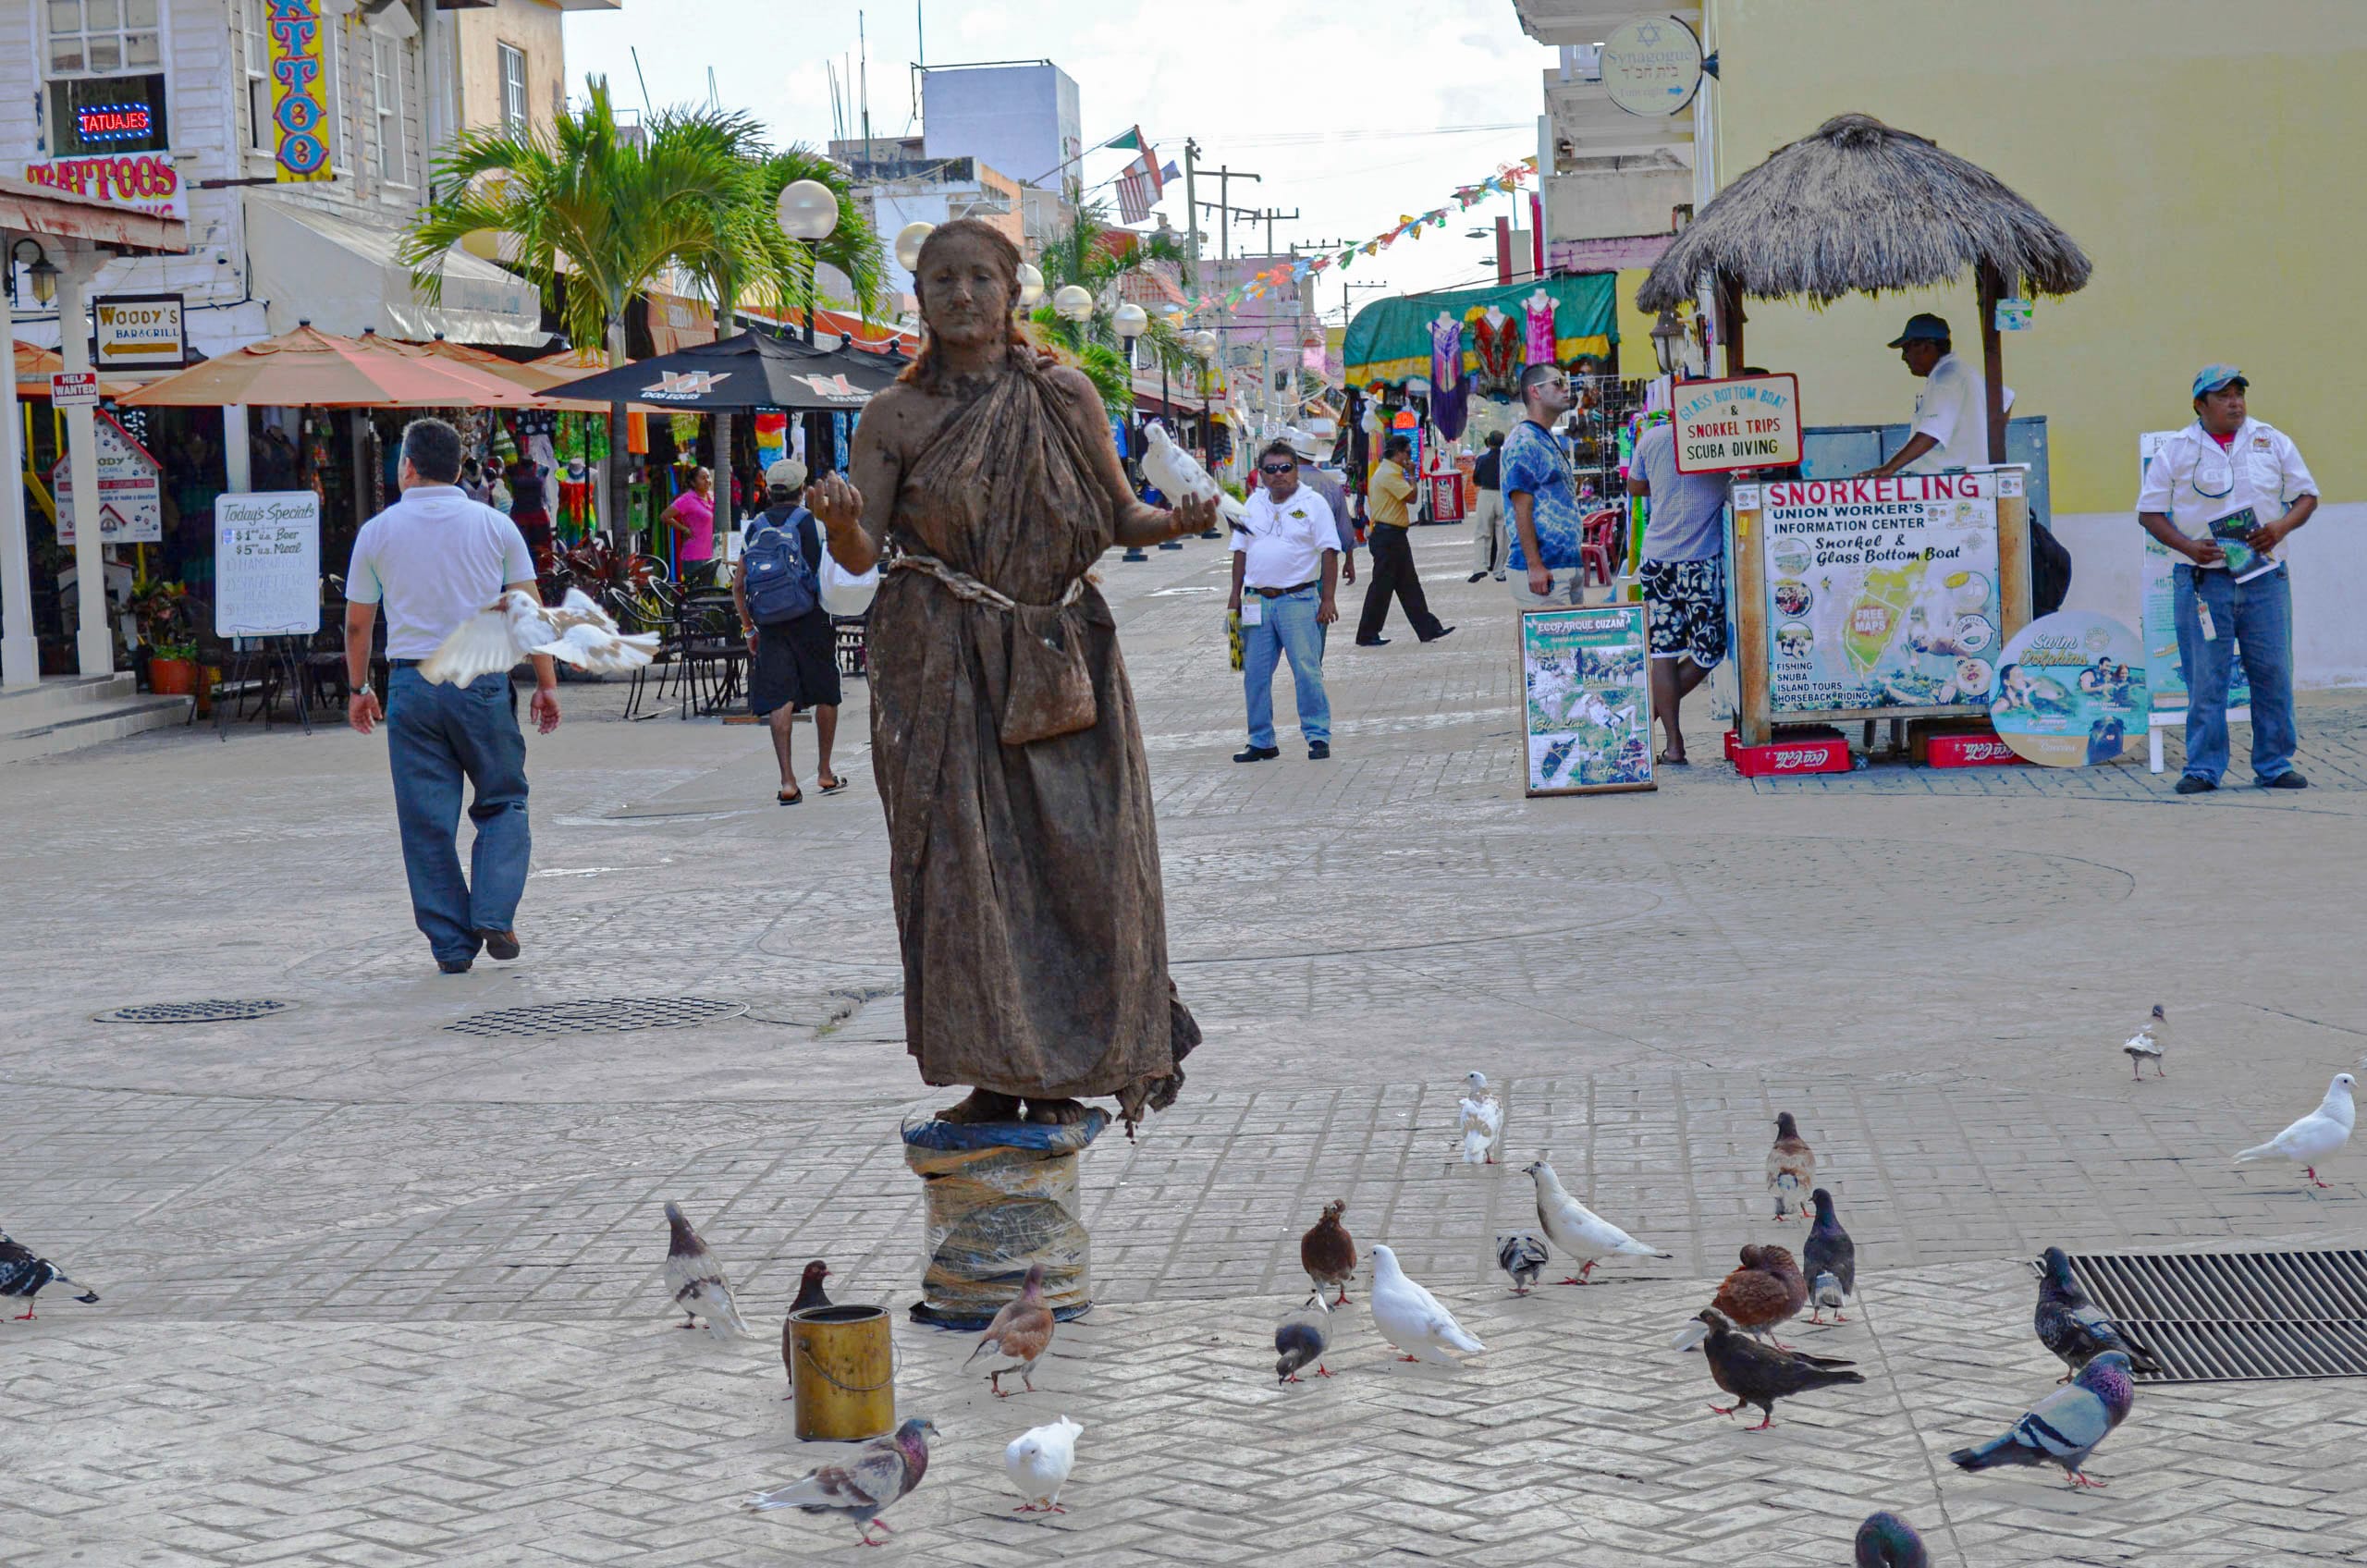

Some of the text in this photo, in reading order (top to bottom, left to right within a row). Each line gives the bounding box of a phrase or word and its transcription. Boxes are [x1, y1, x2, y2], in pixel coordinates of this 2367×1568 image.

[1607, 50, 1694, 67] Synagogue
[80, 112, 148, 131] TATUAJES
[26, 155, 178, 201] TATTOOS
[98, 305, 178, 326] WOODY'S
[61, 374, 87, 385] HELP
[55, 384, 95, 397] WANTED
[640, 390, 701, 400] DOS EQUIS
[1679, 386, 1788, 422] GLASS BOTTOM BOAT
[1731, 405, 1739, 416] &
[1687, 418, 1781, 439] SNORKEL TRIPS
[1687, 439, 1778, 460] SCUBA DIVING
[1769, 473, 1980, 507] SNORKELING
[1439, 487, 1449, 518] TECATE
[223, 502, 314, 526] Today's Specials
[1773, 503, 1924, 520] UNION WORKER'S
[275, 527, 300, 541] Beer
[1773, 517, 1925, 534] INFORMATION CENTER
[274, 542, 302, 555] Meal
[1815, 533, 1907, 550] Snorkel &
[1816, 545, 1960, 568] Glass Bottom Boat
[1856, 608, 1884, 619] FREE
[1538, 619, 1625, 633] ECOPARQUE CUZAM
[1855, 620, 1886, 631] MAPS
[2030, 631, 2079, 650] Swim
[1776, 661, 1813, 671] FISHING
[2018, 648, 2090, 672] Dolphins
[1777, 672, 1808, 682] SNUBA
[1777, 681, 1843, 692] ISLAND TOURS
[1777, 692, 1869, 704] HORSEBACK RIDING
[1559, 718, 1586, 729] Line
